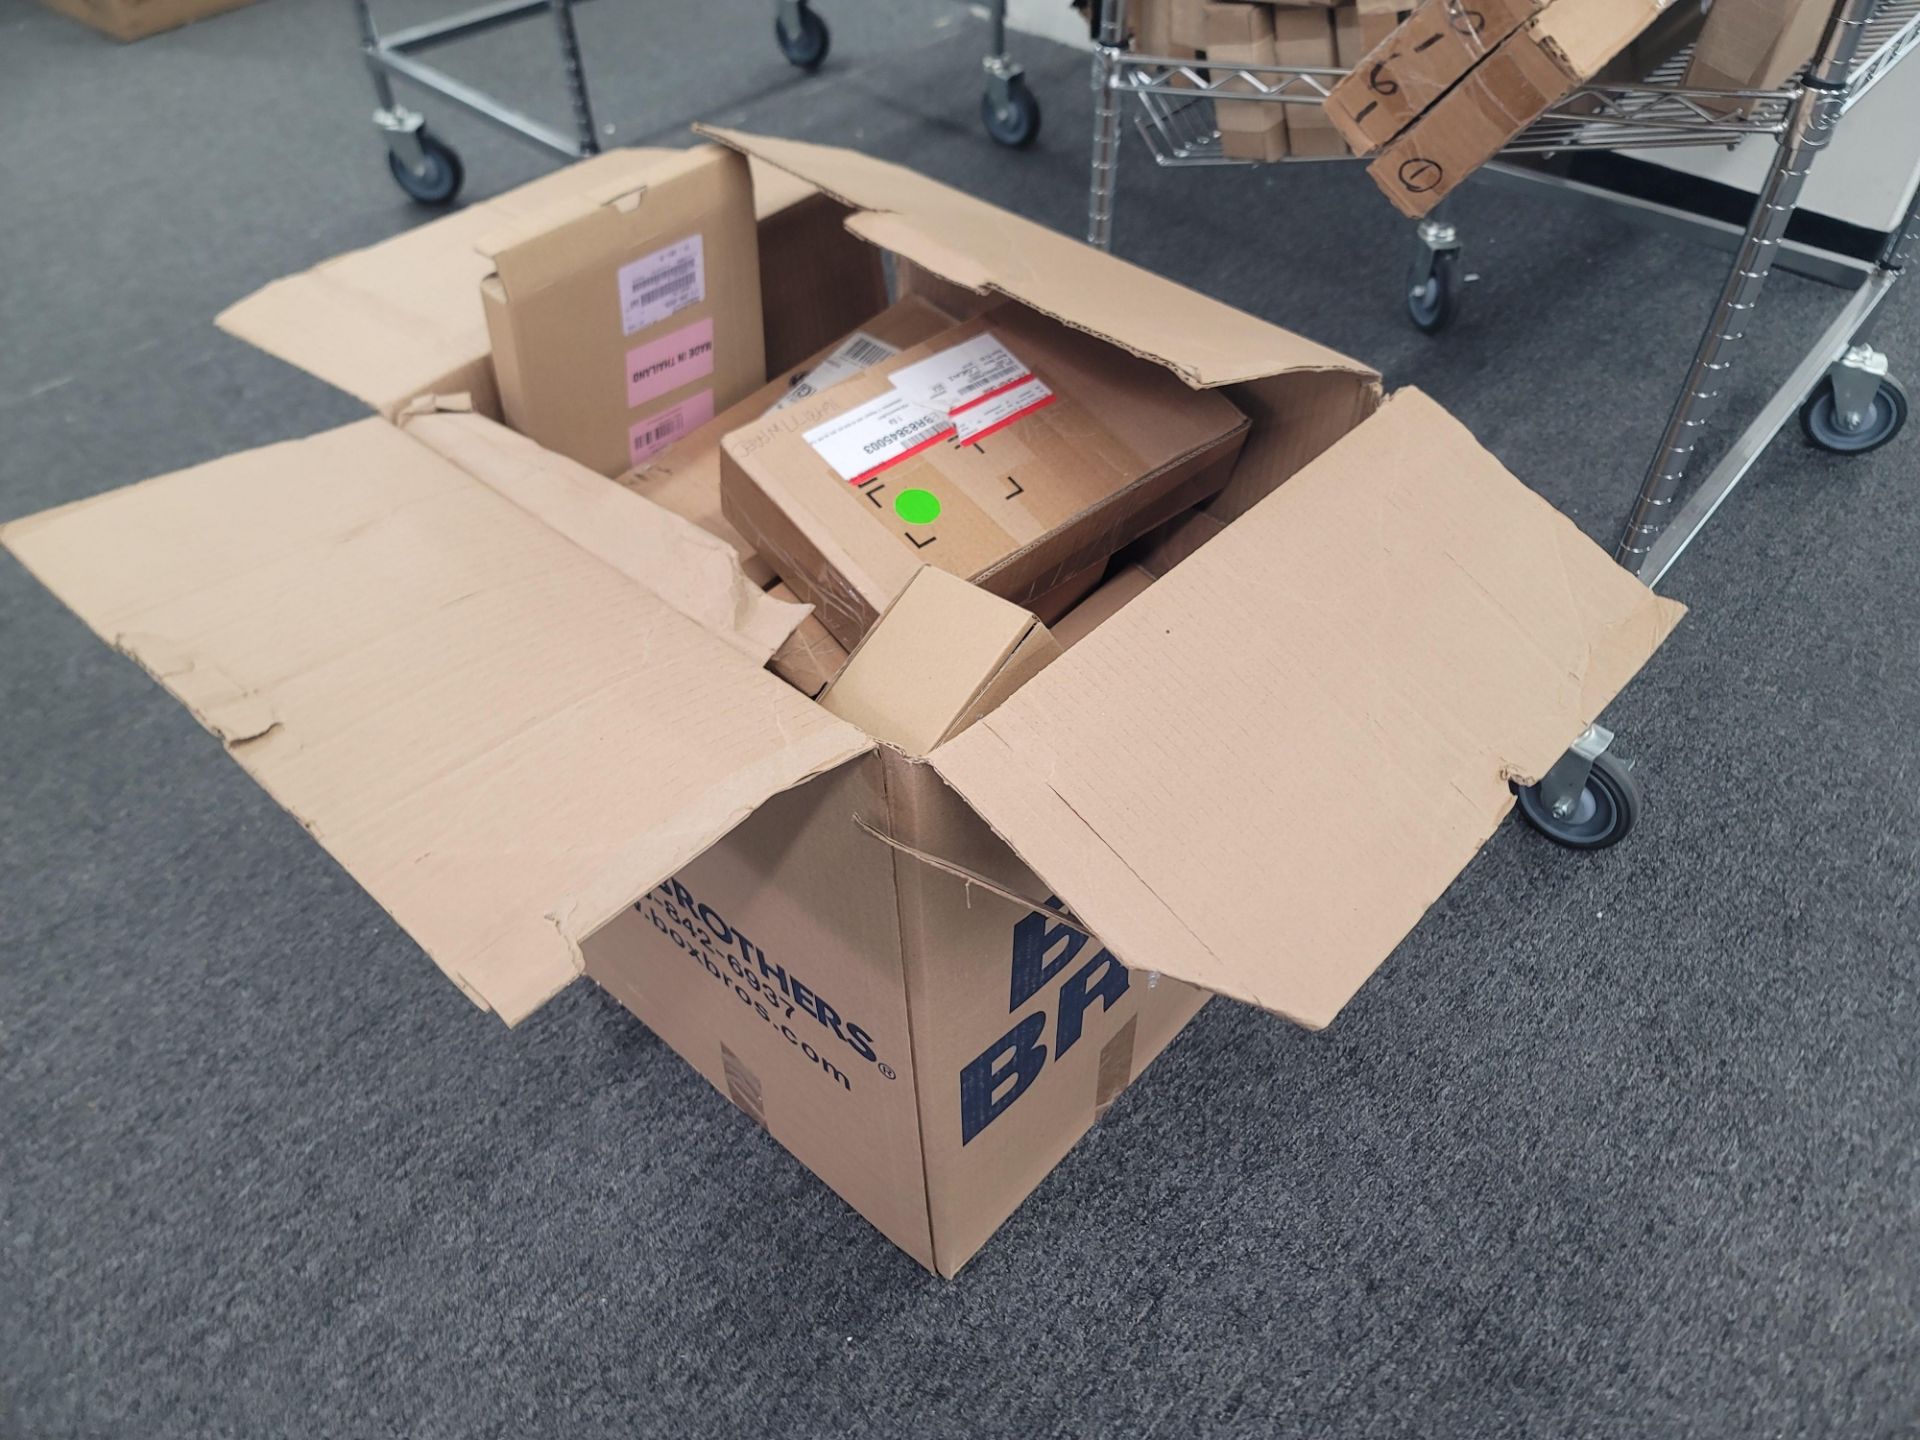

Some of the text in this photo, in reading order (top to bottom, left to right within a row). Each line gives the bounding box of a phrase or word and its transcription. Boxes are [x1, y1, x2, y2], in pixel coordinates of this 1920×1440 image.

[632, 340, 713, 384] MADE IN THAILAND
[634, 900, 851, 1092] .boxbros.com
[645, 891, 796, 1019] -842-6937
